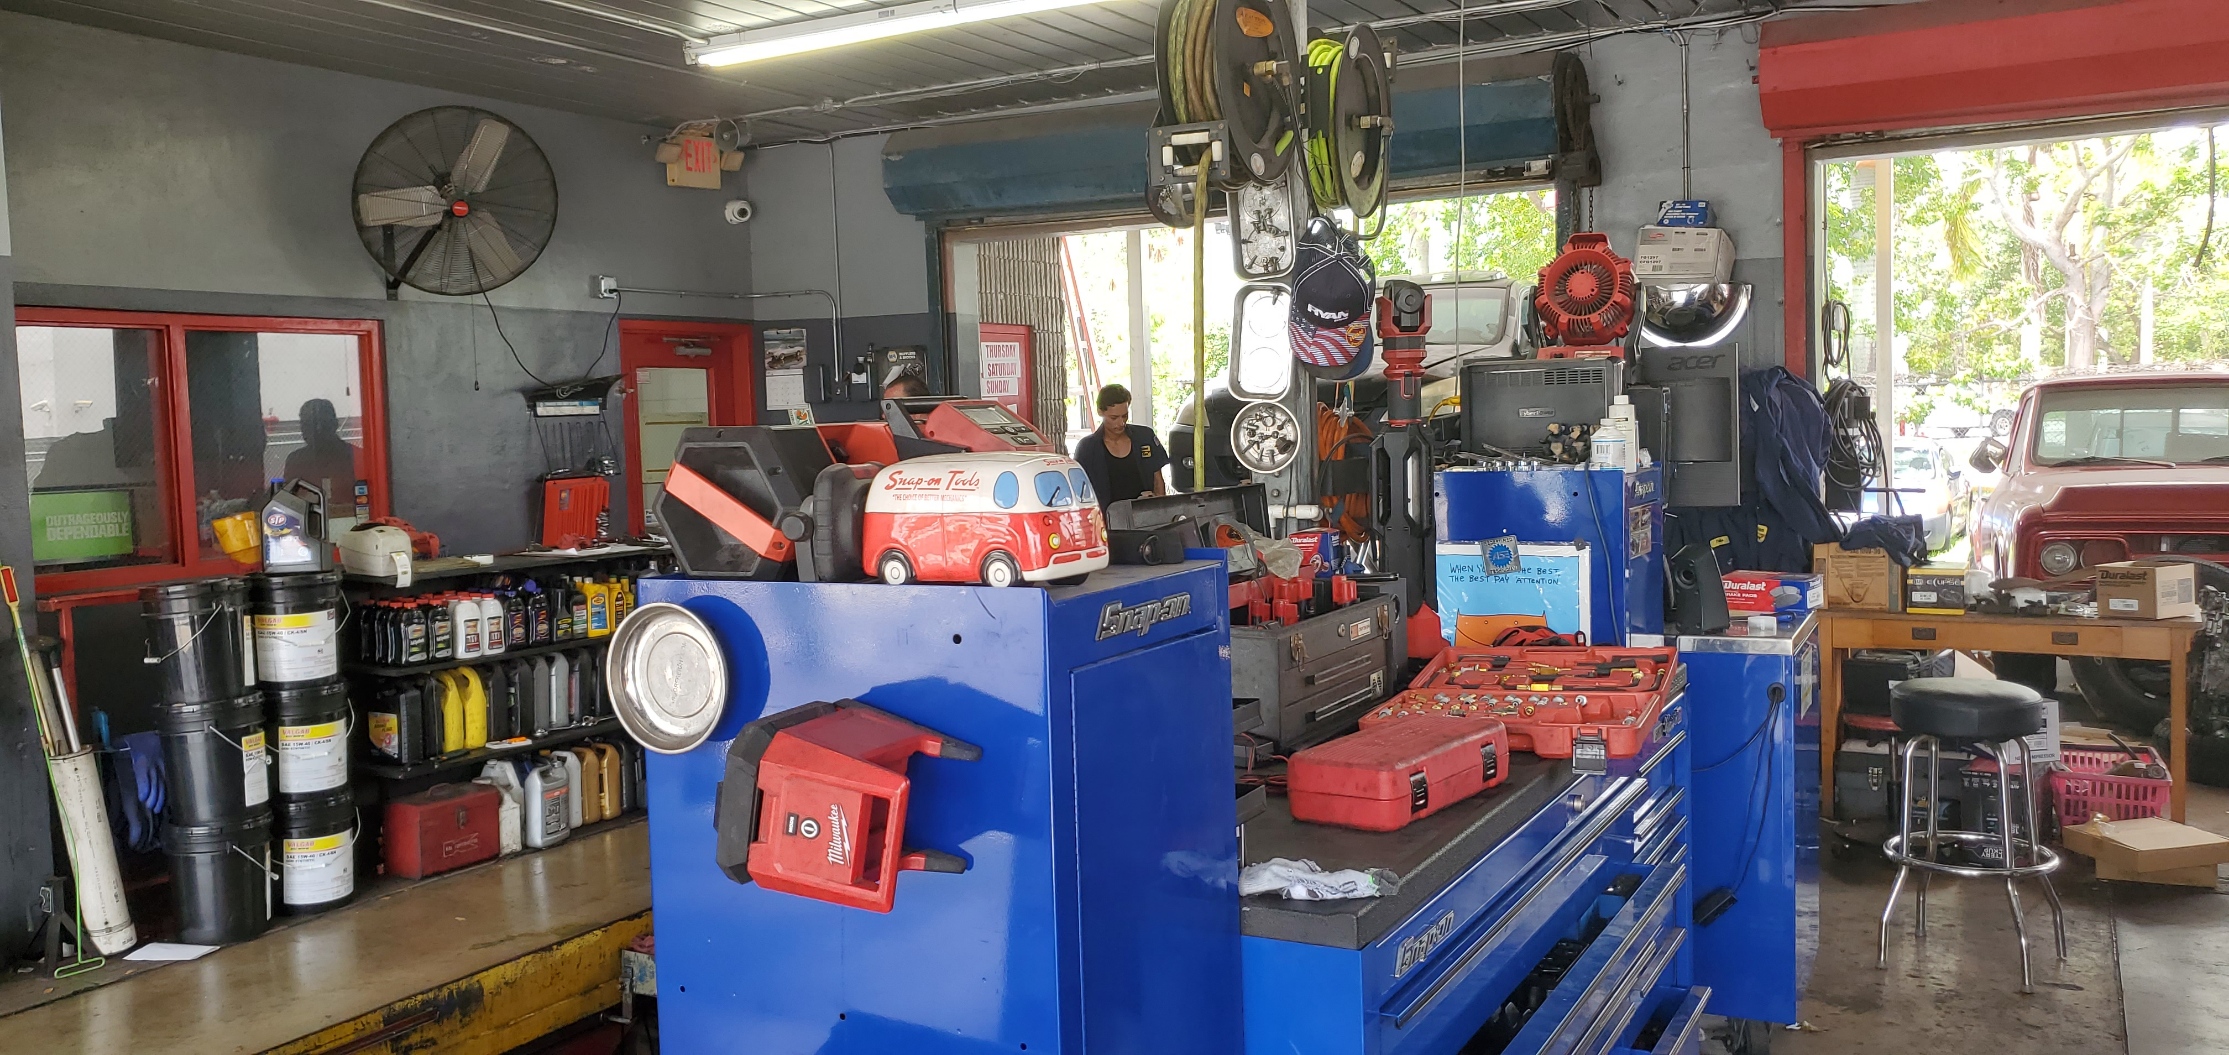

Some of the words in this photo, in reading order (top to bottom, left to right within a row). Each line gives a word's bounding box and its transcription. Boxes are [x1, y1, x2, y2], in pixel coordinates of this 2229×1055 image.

[684, 139, 713, 173] EXIT
[985, 344, 1017, 359] THURSDAY
[987, 362, 1017, 377] SATURDAY
[1666, 354, 1726, 371] acer
[986, 379, 1010, 395] SUNDAY
[884, 470, 943, 491] Snap-on
[945, 470, 980, 491] Tools
[46, 511, 130, 527] OUTRAGEOUSLY
[268, 513, 285, 526] STP
[46, 522, 130, 542] DEPENDABLE
[2098, 569, 2148, 580] Duralast
[1722, 579, 1767, 591] Duralast
[1095, 592, 1192, 641] Snap-on
[827, 803, 845, 866] Milwaukee
